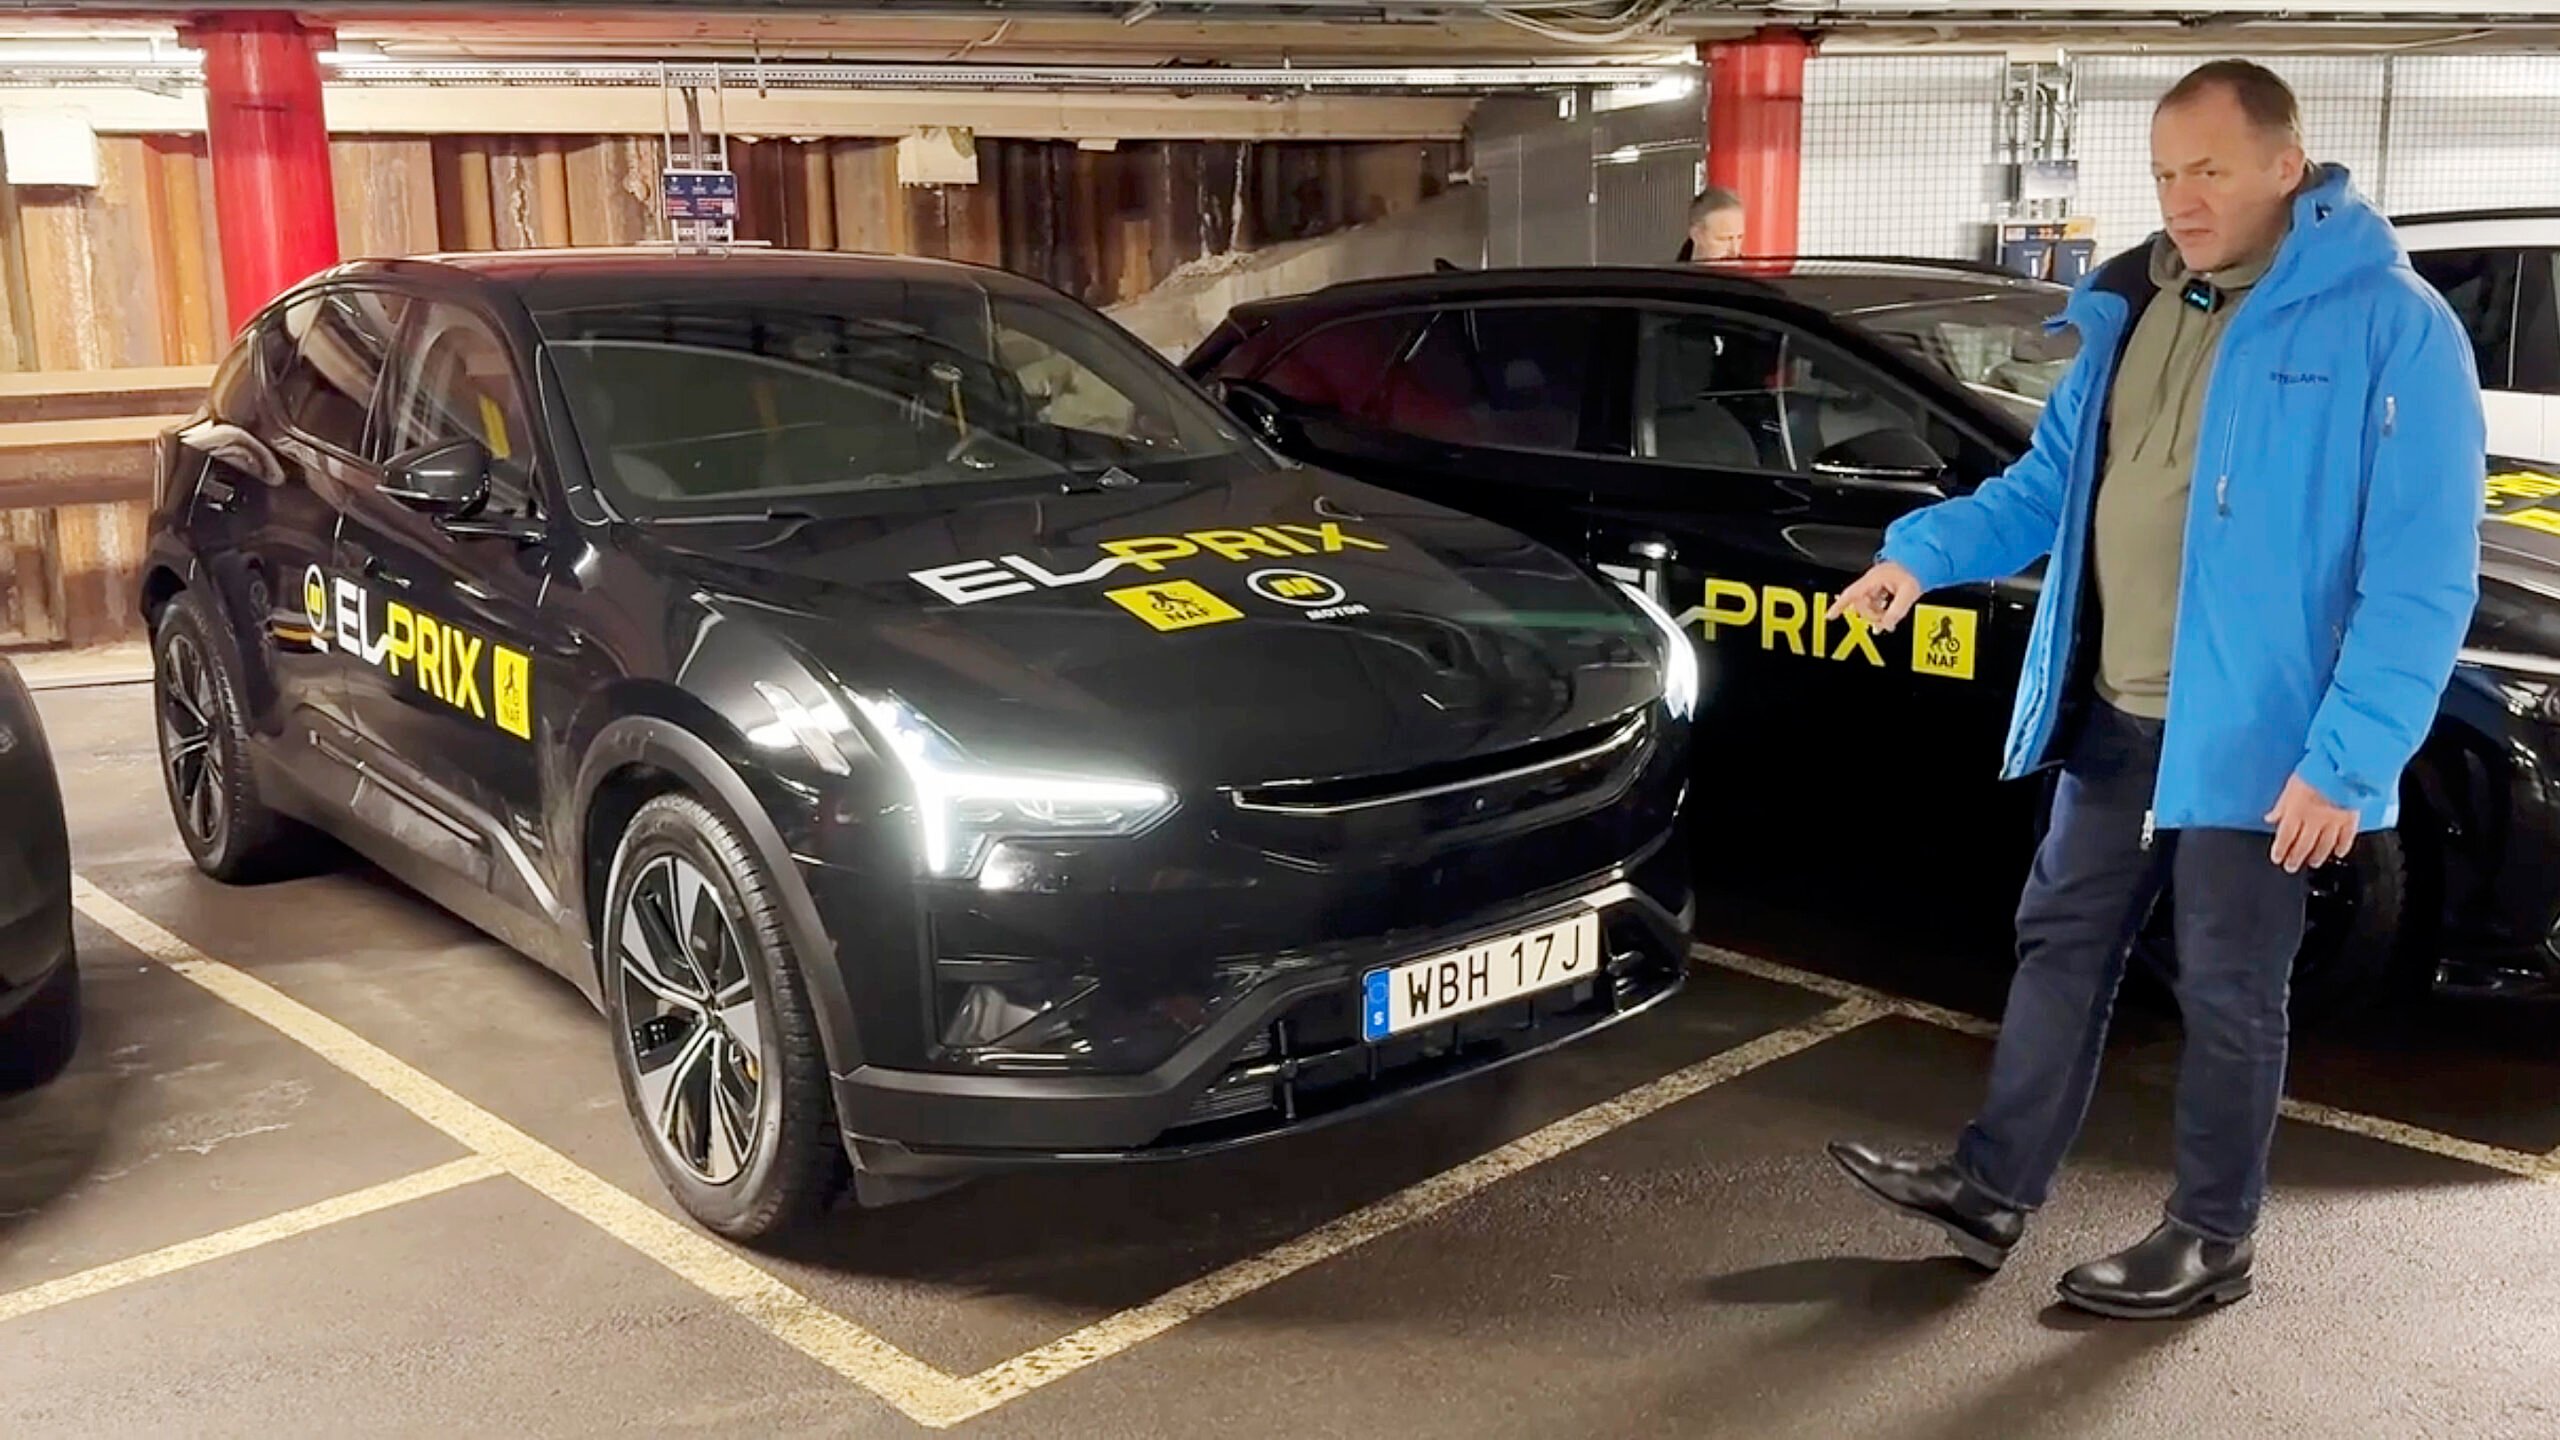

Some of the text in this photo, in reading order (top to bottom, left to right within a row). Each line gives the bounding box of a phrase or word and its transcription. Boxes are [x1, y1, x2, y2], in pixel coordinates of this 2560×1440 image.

[1305, 604, 1370, 620] MOTOR
[1927, 652, 1959, 669] NAF
[1408, 925, 1580, 1017] WBH 17J
[1373, 1011, 1385, 1026] S
